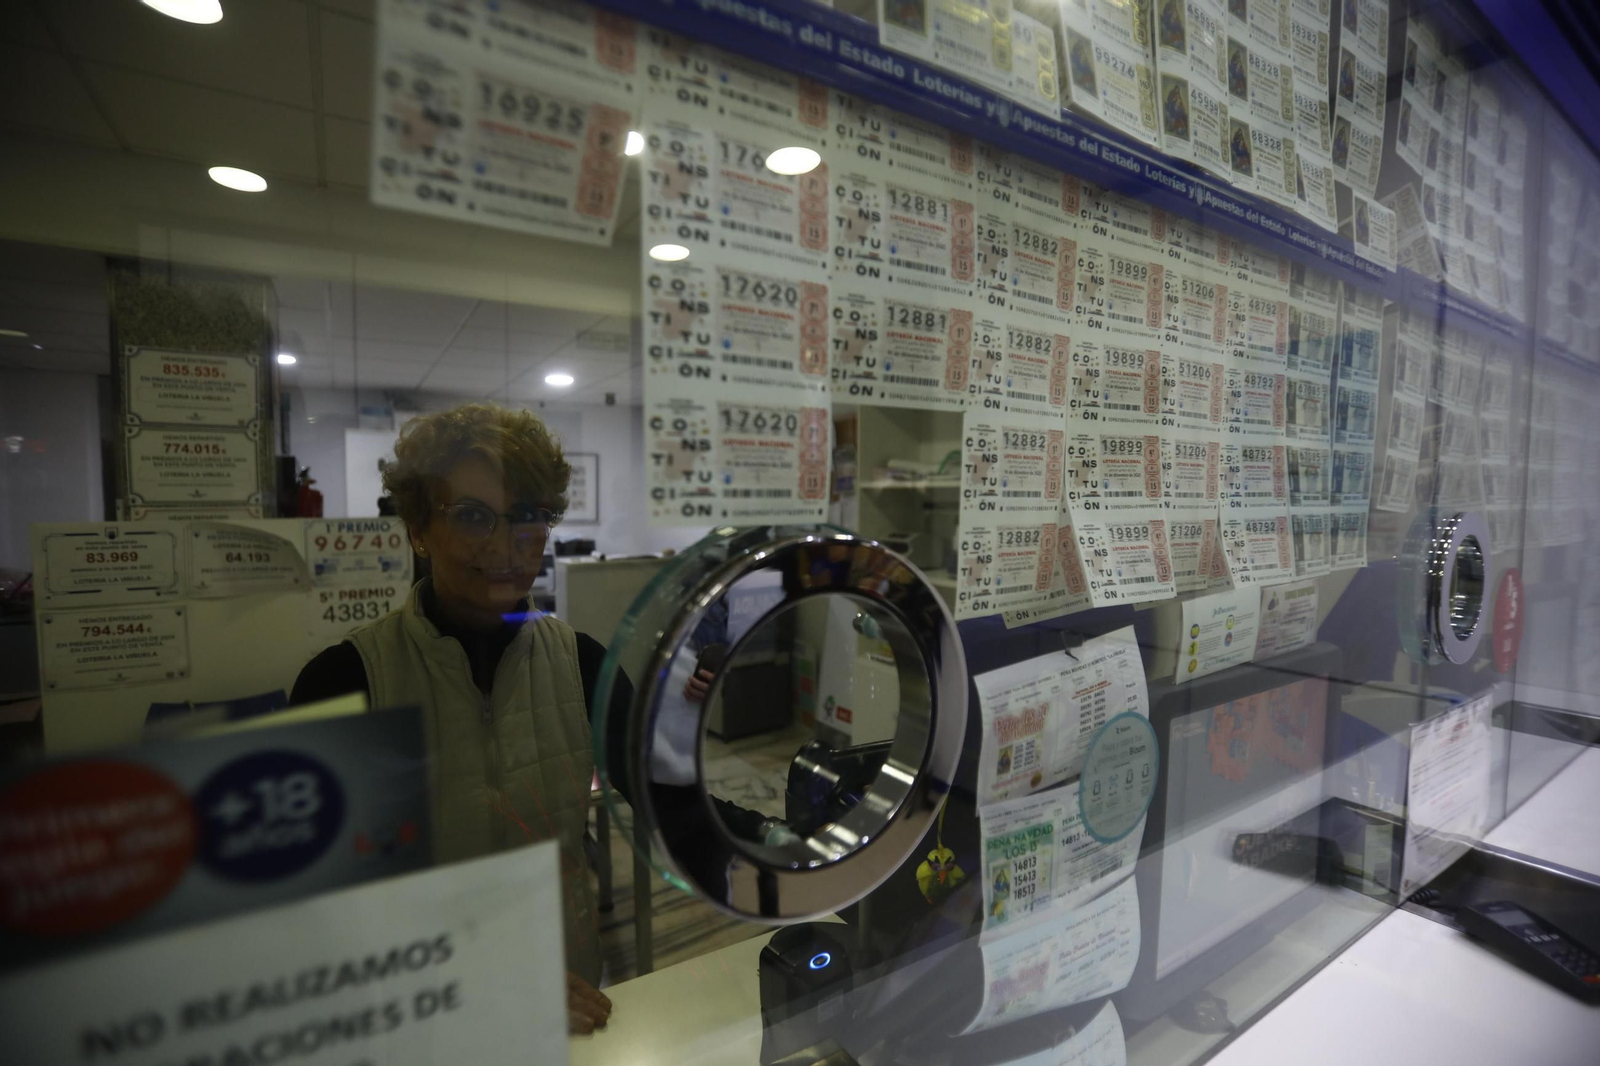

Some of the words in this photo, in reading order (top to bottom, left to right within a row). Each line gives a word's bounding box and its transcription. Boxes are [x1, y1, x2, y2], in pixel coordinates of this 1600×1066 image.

[1250, 54, 1280, 78] 88328
[479, 79, 585, 136] 16925
[800, 24, 833, 51] del
[838, 38, 906, 79] Estado
[1012, 108, 1076, 147] Apuestas
[1079, 137, 1099, 157] del
[1101, 145, 1141, 173] Estado
[1145, 164, 1187, 193] Loterías
[1204, 190, 1245, 218] Apuestas
[1246, 206, 1259, 224] del
[1260, 216, 1286, 236] Estado
[1251, 129, 1283, 152] 88328
[888, 188, 949, 219] 12881
[1012, 228, 1059, 256] 12882
[1109, 258, 1148, 280] 19899
[720, 273, 798, 305] 17620
[1182, 279, 1215, 299] 51206
[1248, 299, 1277, 315] 48792
[886, 306, 947, 330] 12881
[1008, 331, 1051, 354] 12882
[1105, 349, 1144, 367] 19899
[163, 364, 221, 378] 835.535
[1178, 362, 1211, 379] 51206
[1244, 370, 1273, 388] 48792
[721, 408, 798, 434] 17620
[164, 443, 221, 455] 774.015
[1003, 431, 1046, 450] 12882
[1102, 438, 1143, 454] 19899
[1174, 444, 1206, 458] 51206
[1241, 448, 1273, 461] 48792
[337, 521, 391, 534] PREMIO
[1108, 525, 1150, 541] 19899
[1170, 523, 1202, 538] 51206
[1245, 521, 1276, 533] 48792
[313, 533, 402, 551] 96740
[998, 530, 1041, 547] 12882
[86, 552, 139, 564] 83.969
[226, 552, 271, 564] 64.193
[339, 586, 397, 600] PREMIO
[322, 600, 392, 623] 43831
[81, 622, 145, 638] 794.544
[212, 771, 324, 825] +18
[1013, 823, 1055, 844] NAVIDAD
[1013, 856, 1038, 874] 14813
[1013, 869, 1037, 888] 15413
[1013, 883, 1037, 901] 18513
[79, 1010, 166, 1062] NO
[178, 931, 455, 1031] REALIZAMOS
[411, 981, 463, 1022] DE
